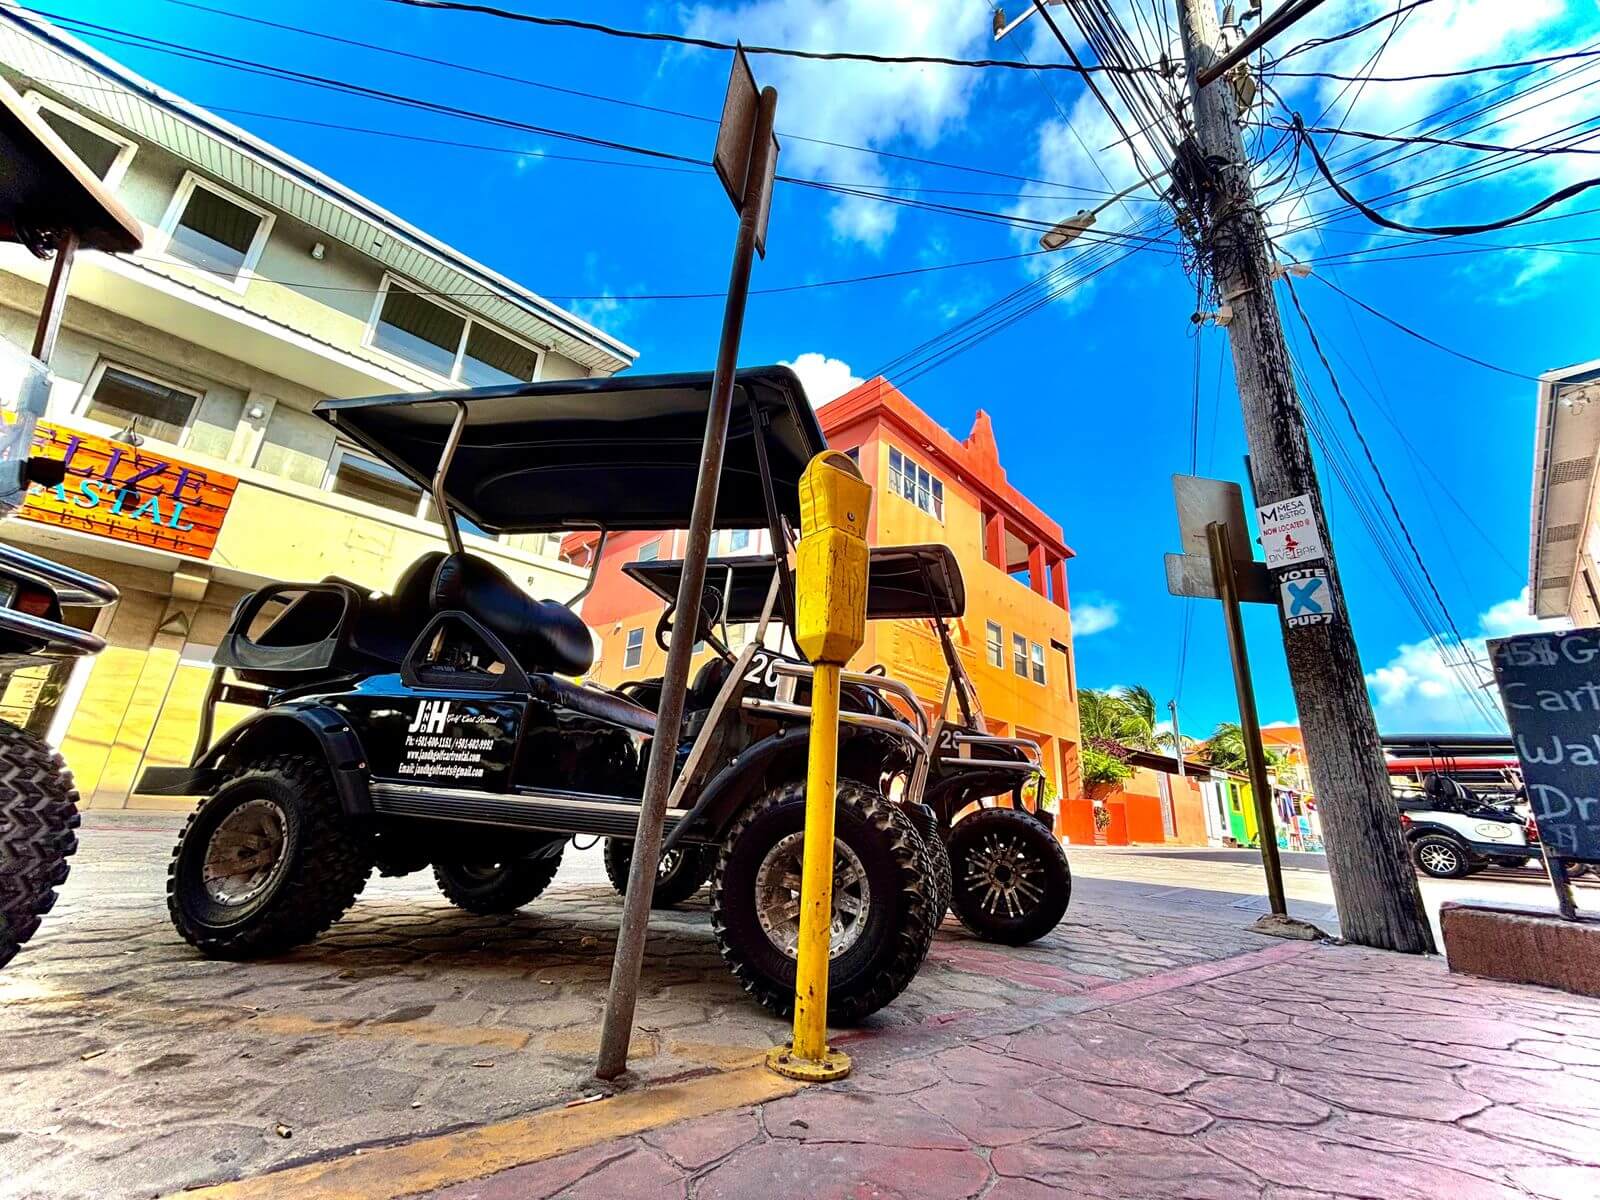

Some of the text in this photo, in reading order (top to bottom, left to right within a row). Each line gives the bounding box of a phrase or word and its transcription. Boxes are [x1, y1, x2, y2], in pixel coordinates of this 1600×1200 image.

[1278, 500, 1304, 513] MESA
[1279, 508, 1307, 521] BISTRO
[1263, 527, 1278, 536] NOW
[1279, 520, 1305, 533] LOCATED
[1268, 545, 1317, 563] DIVE BAR
[1279, 568, 1327, 582] VOTE
[1560, 636, 1600, 665] G
